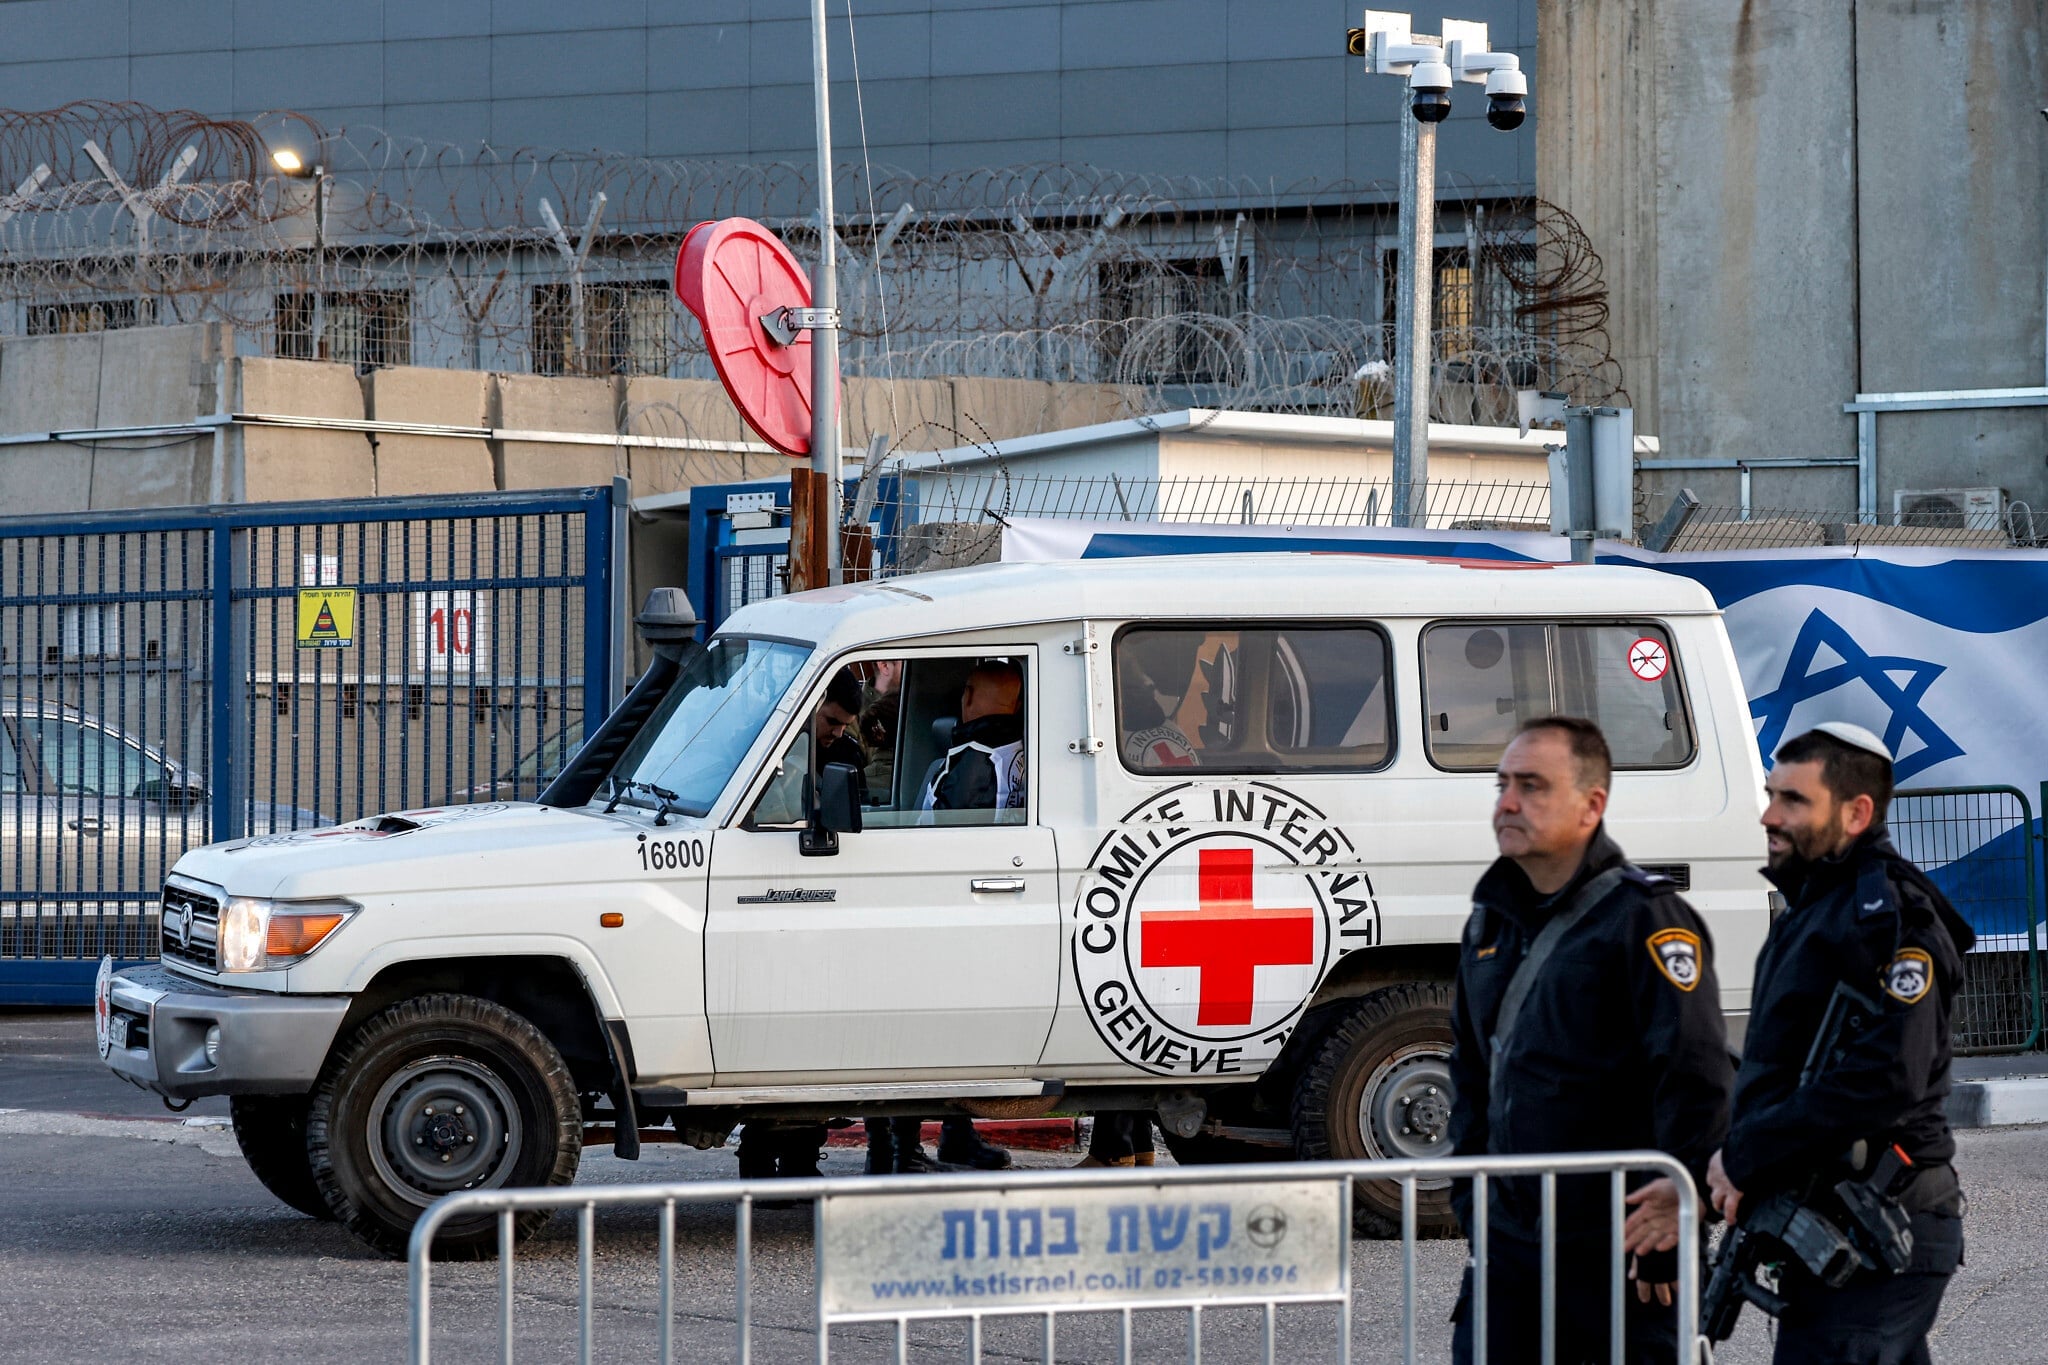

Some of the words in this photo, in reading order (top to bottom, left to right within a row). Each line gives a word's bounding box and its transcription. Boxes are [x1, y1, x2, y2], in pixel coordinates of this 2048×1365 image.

[430, 608, 471, 655] 10
[637, 838, 704, 871] 16800
[1093, 980, 1244, 1074] GENEVE
[941, 1206, 1079, 1260] במות
[1106, 1202, 1232, 1260] קשת
[871, 1265, 1141, 1300] www.kstisrael.co.il
[1154, 1264, 1298, 1290] 02-5839696
